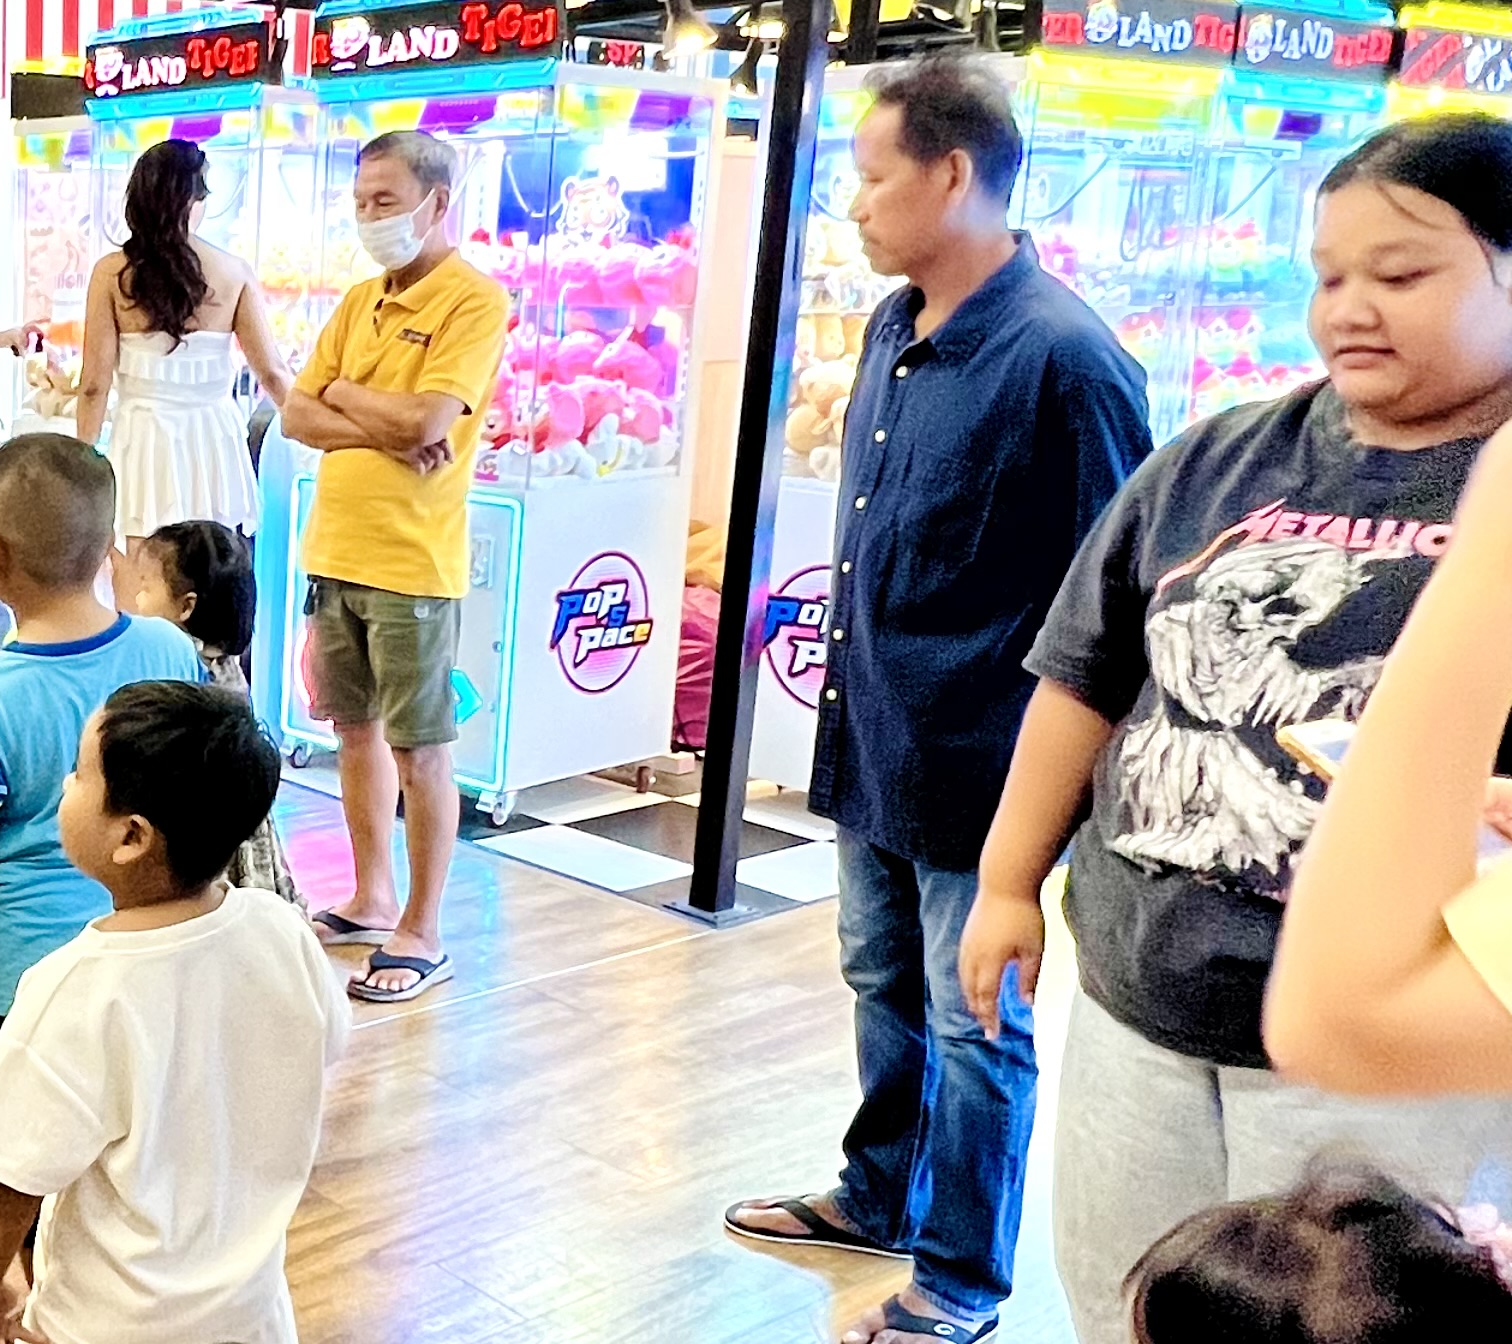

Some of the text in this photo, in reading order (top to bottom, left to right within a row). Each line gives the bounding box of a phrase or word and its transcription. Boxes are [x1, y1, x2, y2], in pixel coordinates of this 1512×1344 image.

[366, 25, 460, 67] LAND
[1117, 11, 1192, 53] LAND
[1272, 18, 1334, 60] LAND
[121, 56, 187, 91] LAND
